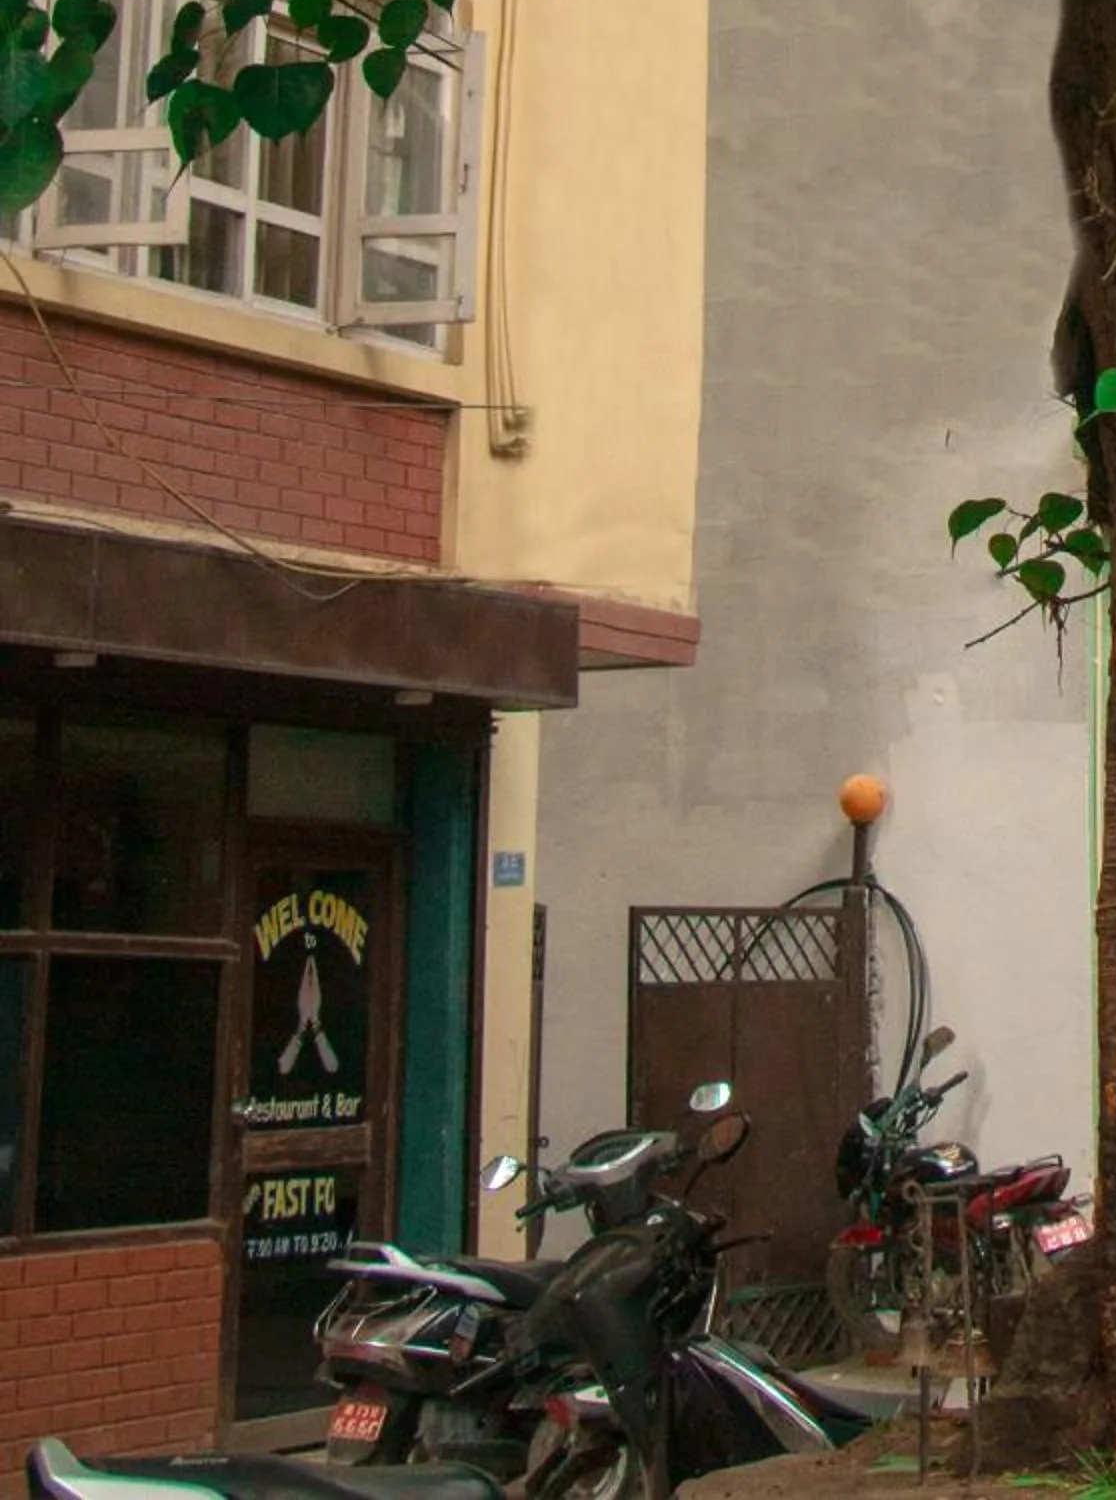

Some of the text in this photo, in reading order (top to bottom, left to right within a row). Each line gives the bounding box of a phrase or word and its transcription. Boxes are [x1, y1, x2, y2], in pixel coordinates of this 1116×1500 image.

[304, 932, 317, 949] to
[321, 1093, 332, 1120] &
[336, 1093, 361, 1117] Bar
[263, 1178, 311, 1220] FAST
